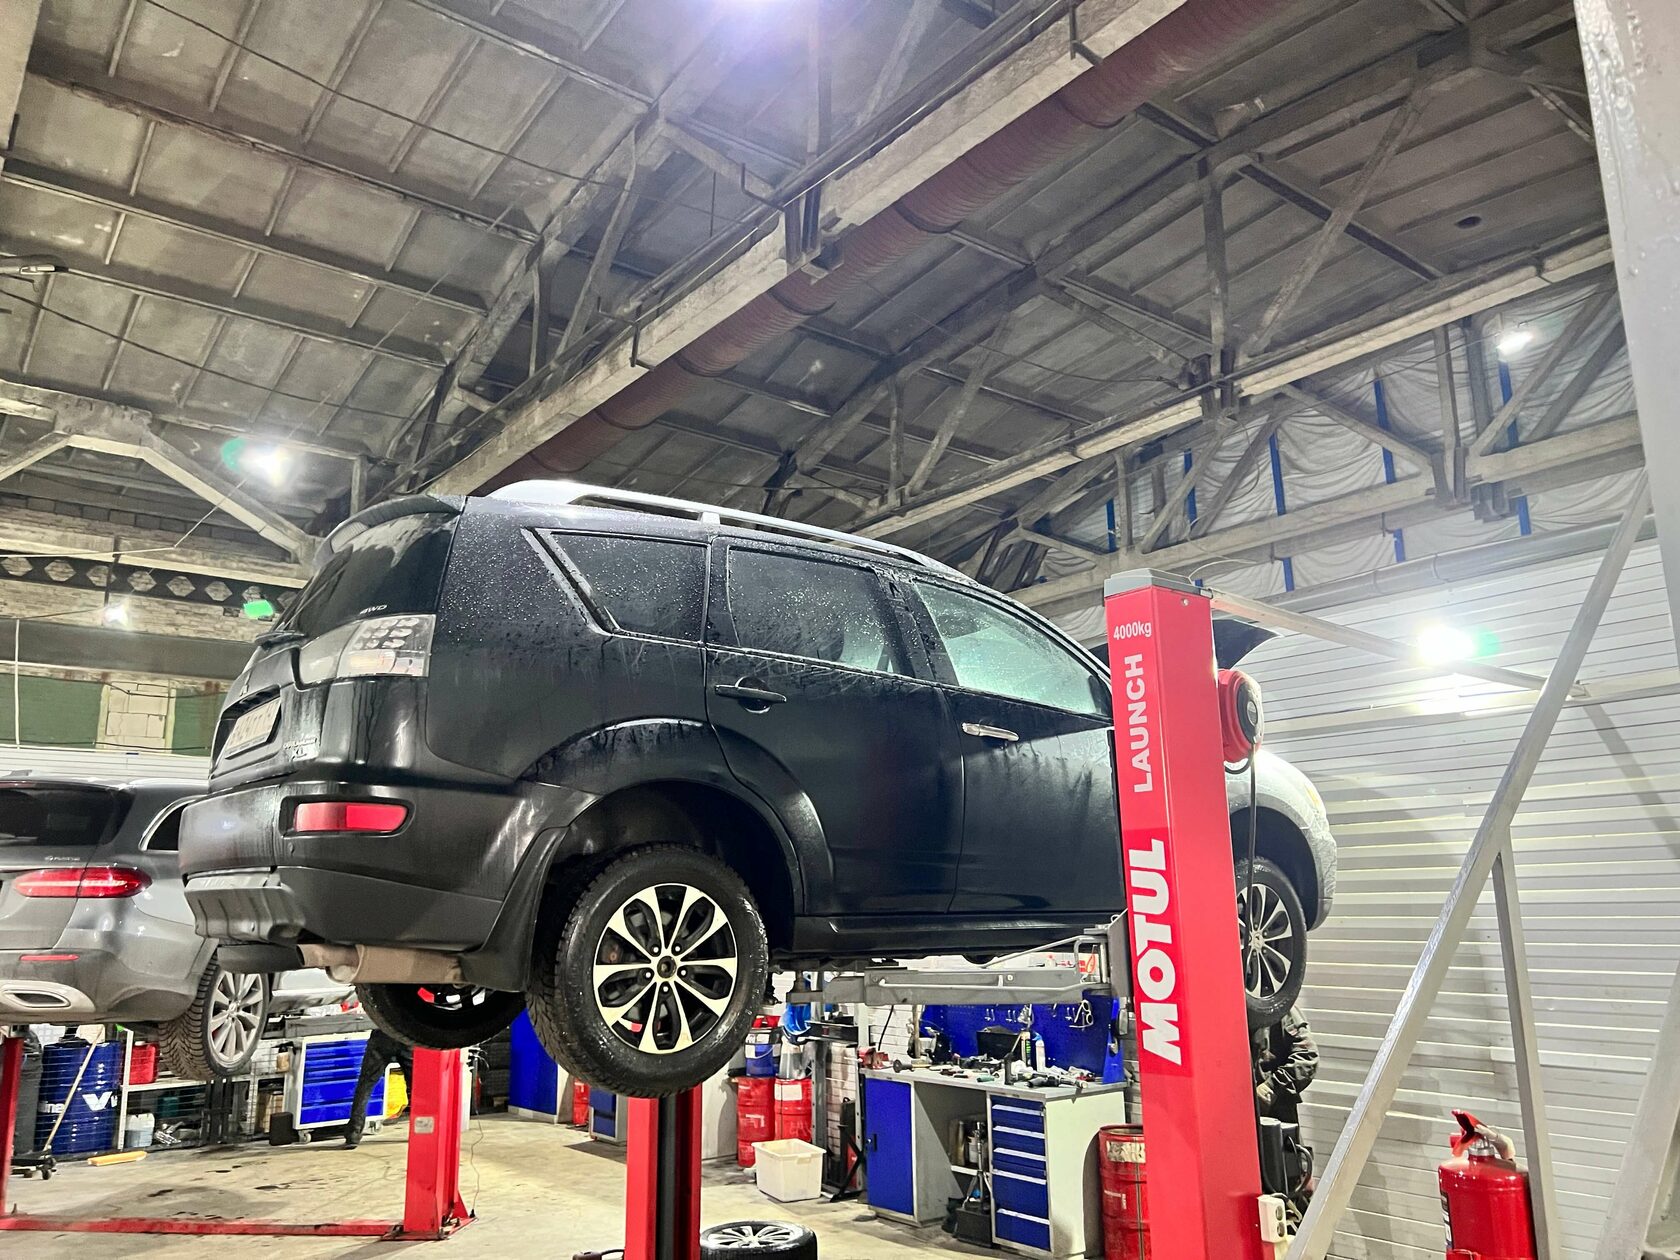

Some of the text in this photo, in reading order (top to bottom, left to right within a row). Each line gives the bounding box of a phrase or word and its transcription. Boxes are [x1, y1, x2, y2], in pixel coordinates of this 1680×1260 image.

[1113, 620, 1152, 640] 4000kg
[1124, 653, 1153, 793] LAUNCH
[1128, 839, 1182, 1066] MOTUL
